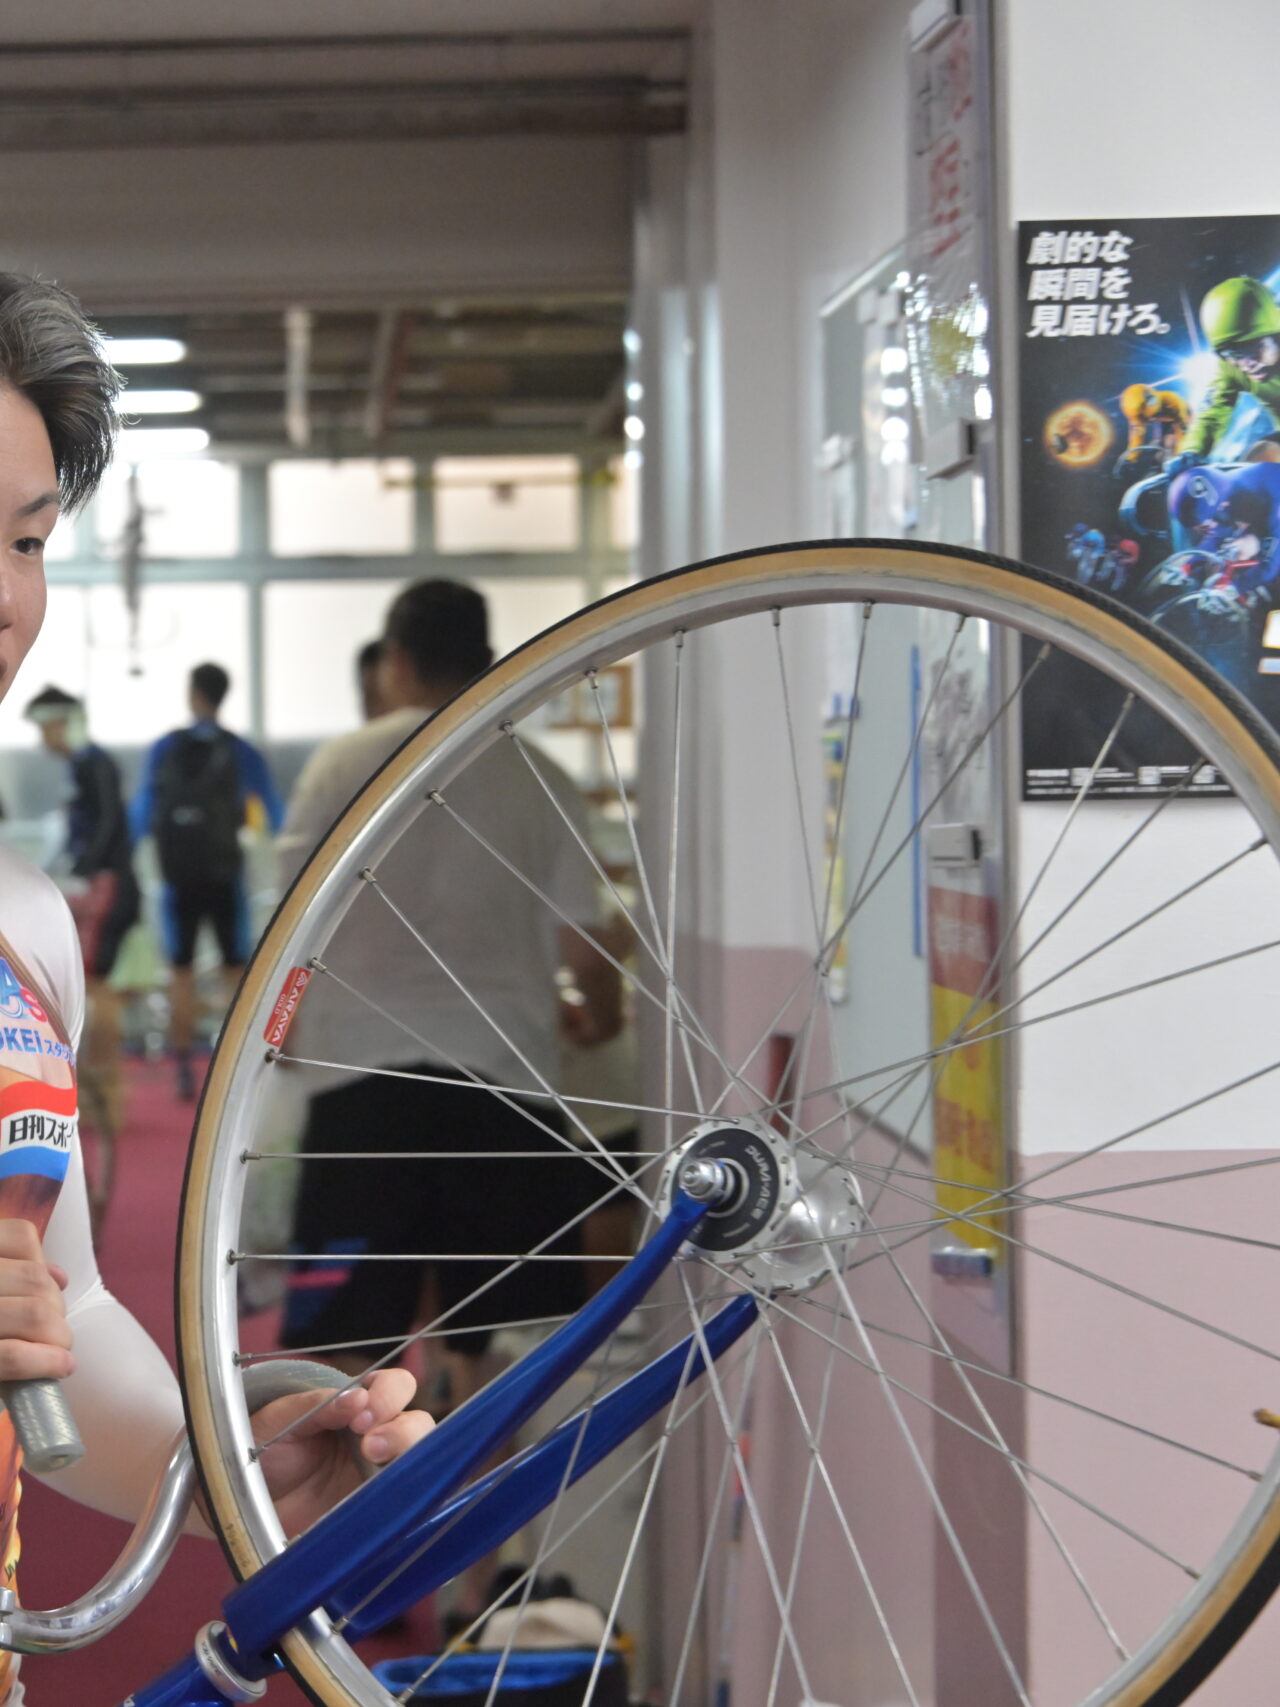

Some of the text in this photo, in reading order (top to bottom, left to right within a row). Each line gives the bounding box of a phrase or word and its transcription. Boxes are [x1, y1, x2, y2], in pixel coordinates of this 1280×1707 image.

[1026, 230, 1134, 264] 劇的な
[1027, 267, 1132, 301] 瞬間を
[1025, 303, 1171, 338] 見届けろ。
[271, 986, 299, 1042] ARAYA
